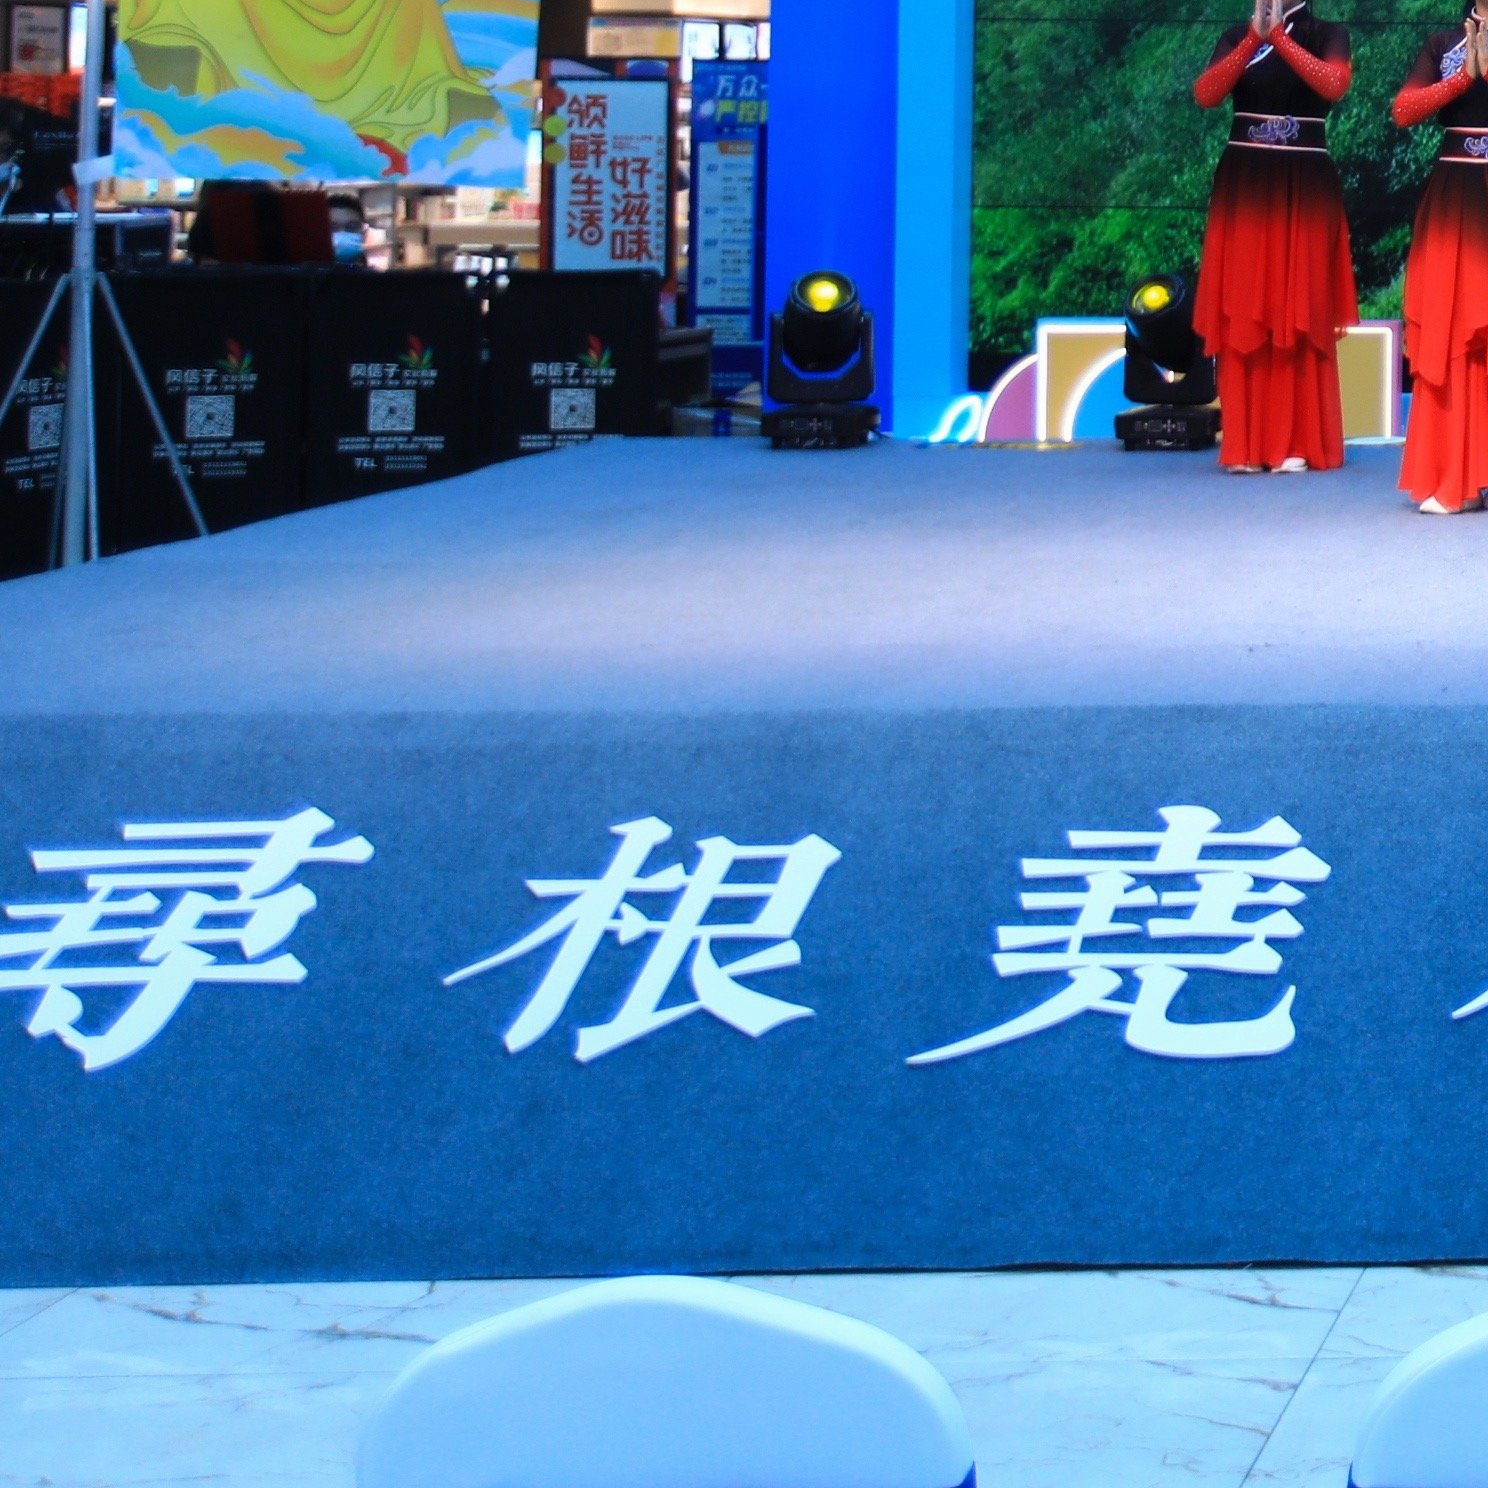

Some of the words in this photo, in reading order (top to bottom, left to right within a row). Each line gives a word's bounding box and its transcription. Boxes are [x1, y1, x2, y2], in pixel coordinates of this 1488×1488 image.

[566, 94, 609, 246] 领鲜生活
[609, 156, 656, 263] 好滋味
